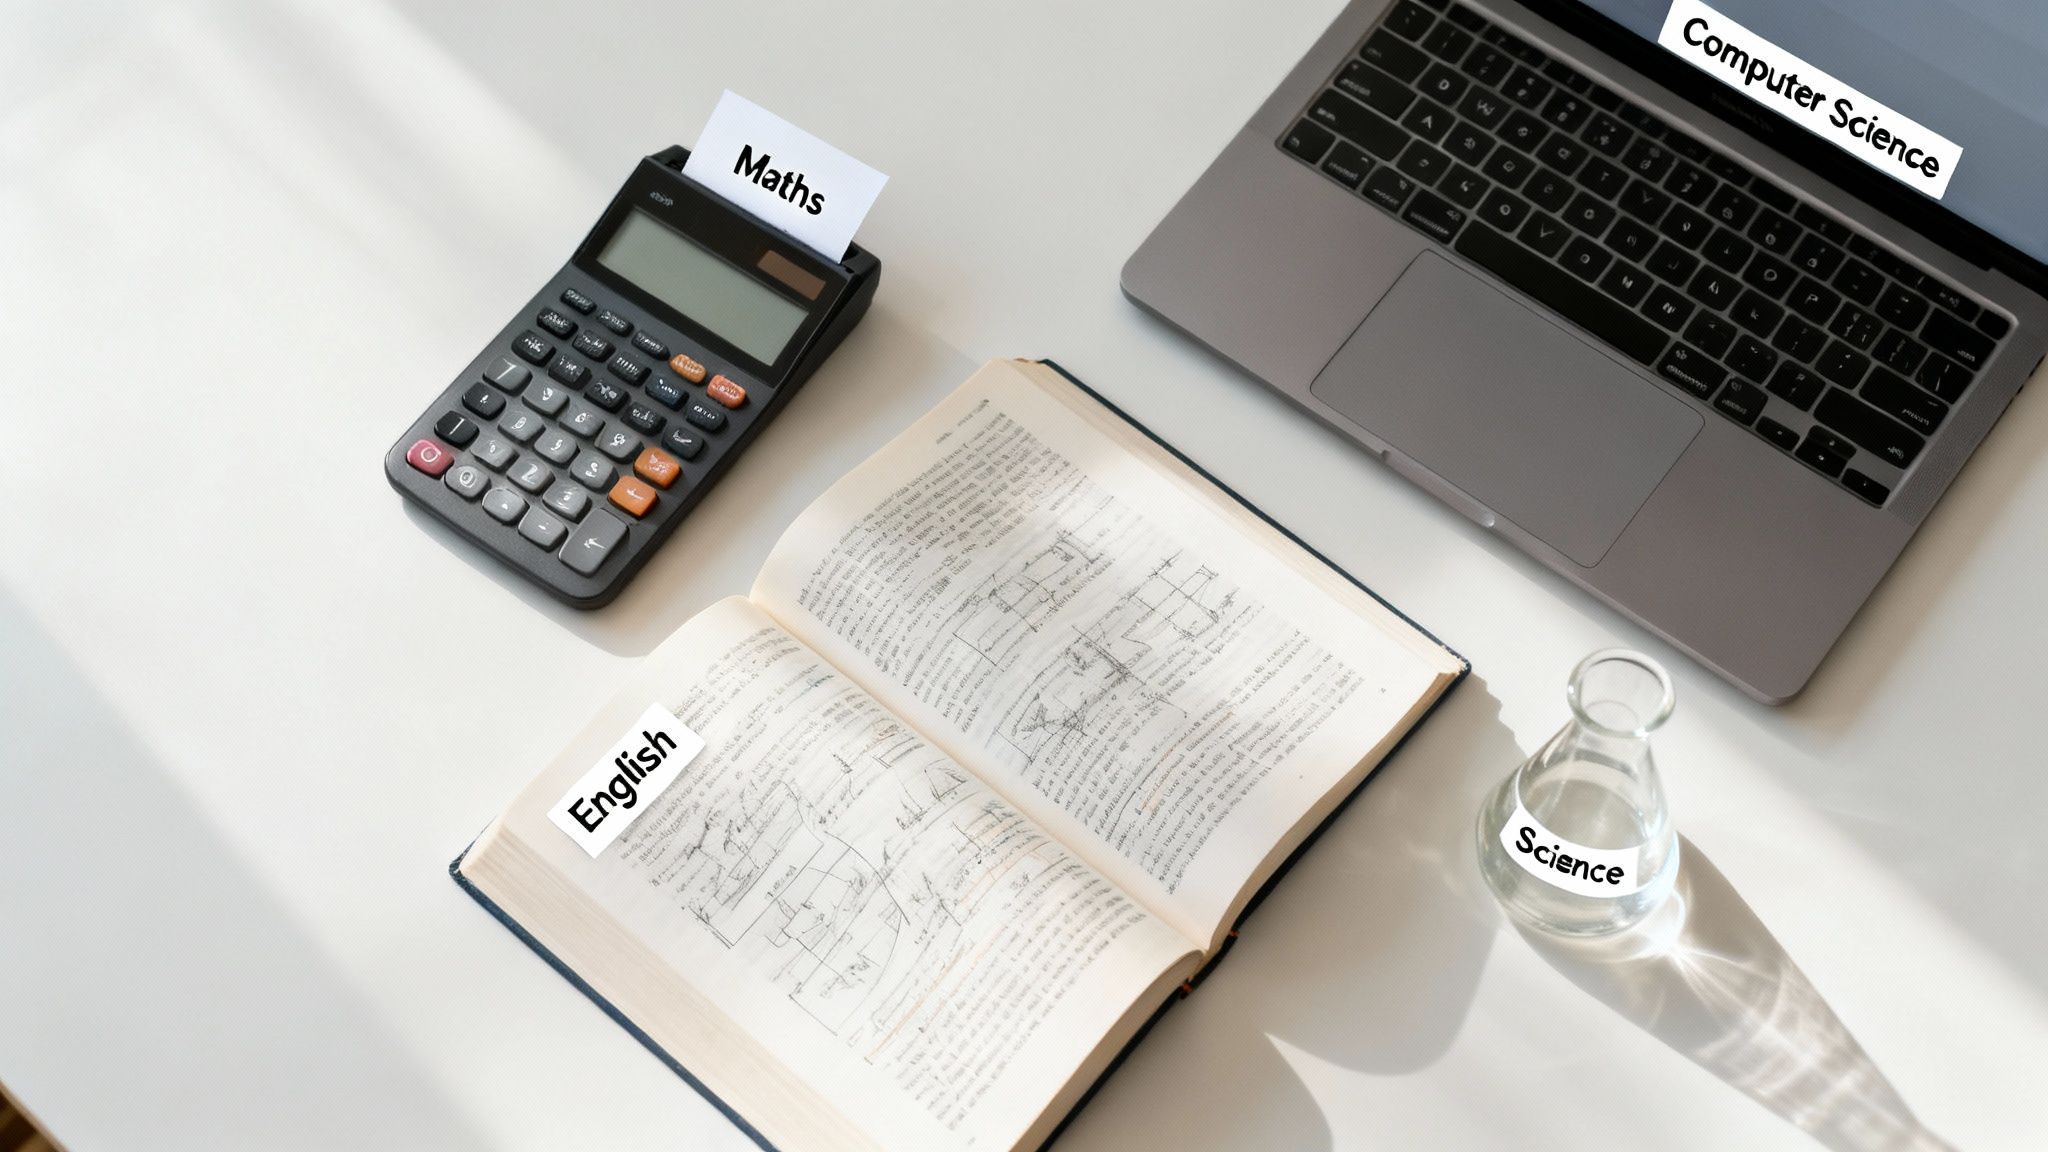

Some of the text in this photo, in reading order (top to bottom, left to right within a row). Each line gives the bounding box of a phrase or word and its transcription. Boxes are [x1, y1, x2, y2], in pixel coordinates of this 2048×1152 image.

[1683, 17, 1940, 178] Computer Science
[733, 143, 826, 216] Maths
[567, 720, 678, 833] English
[1515, 826, 1625, 885] Science
